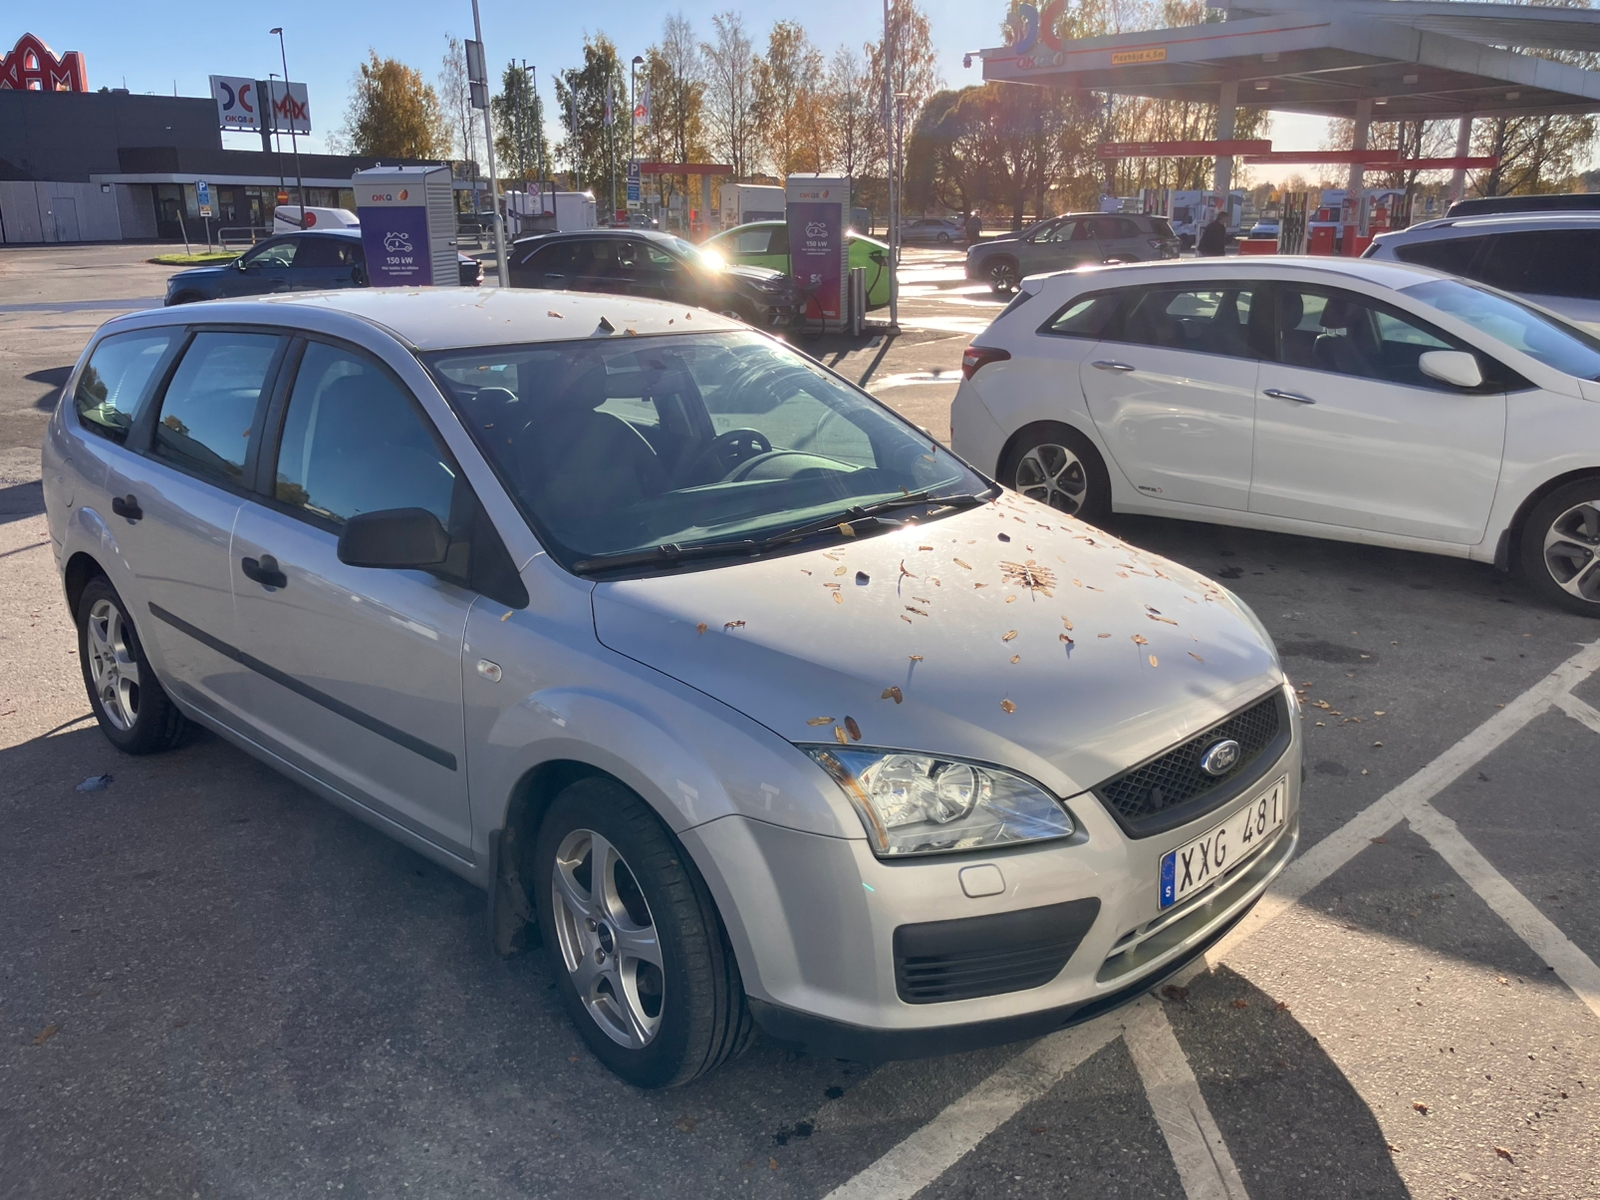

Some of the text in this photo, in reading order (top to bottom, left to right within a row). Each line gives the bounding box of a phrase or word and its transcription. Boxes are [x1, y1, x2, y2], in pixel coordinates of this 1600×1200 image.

[272, 92, 307, 120] MAX
[630, 163, 639, 176] P
[199, 182, 206, 191] P
[386, 256, 413, 264] 150 kW
[1216, 747, 1235, 768] Ford
[1179, 787, 1279, 893] XXG 481
[1165, 886, 1172, 898] S
